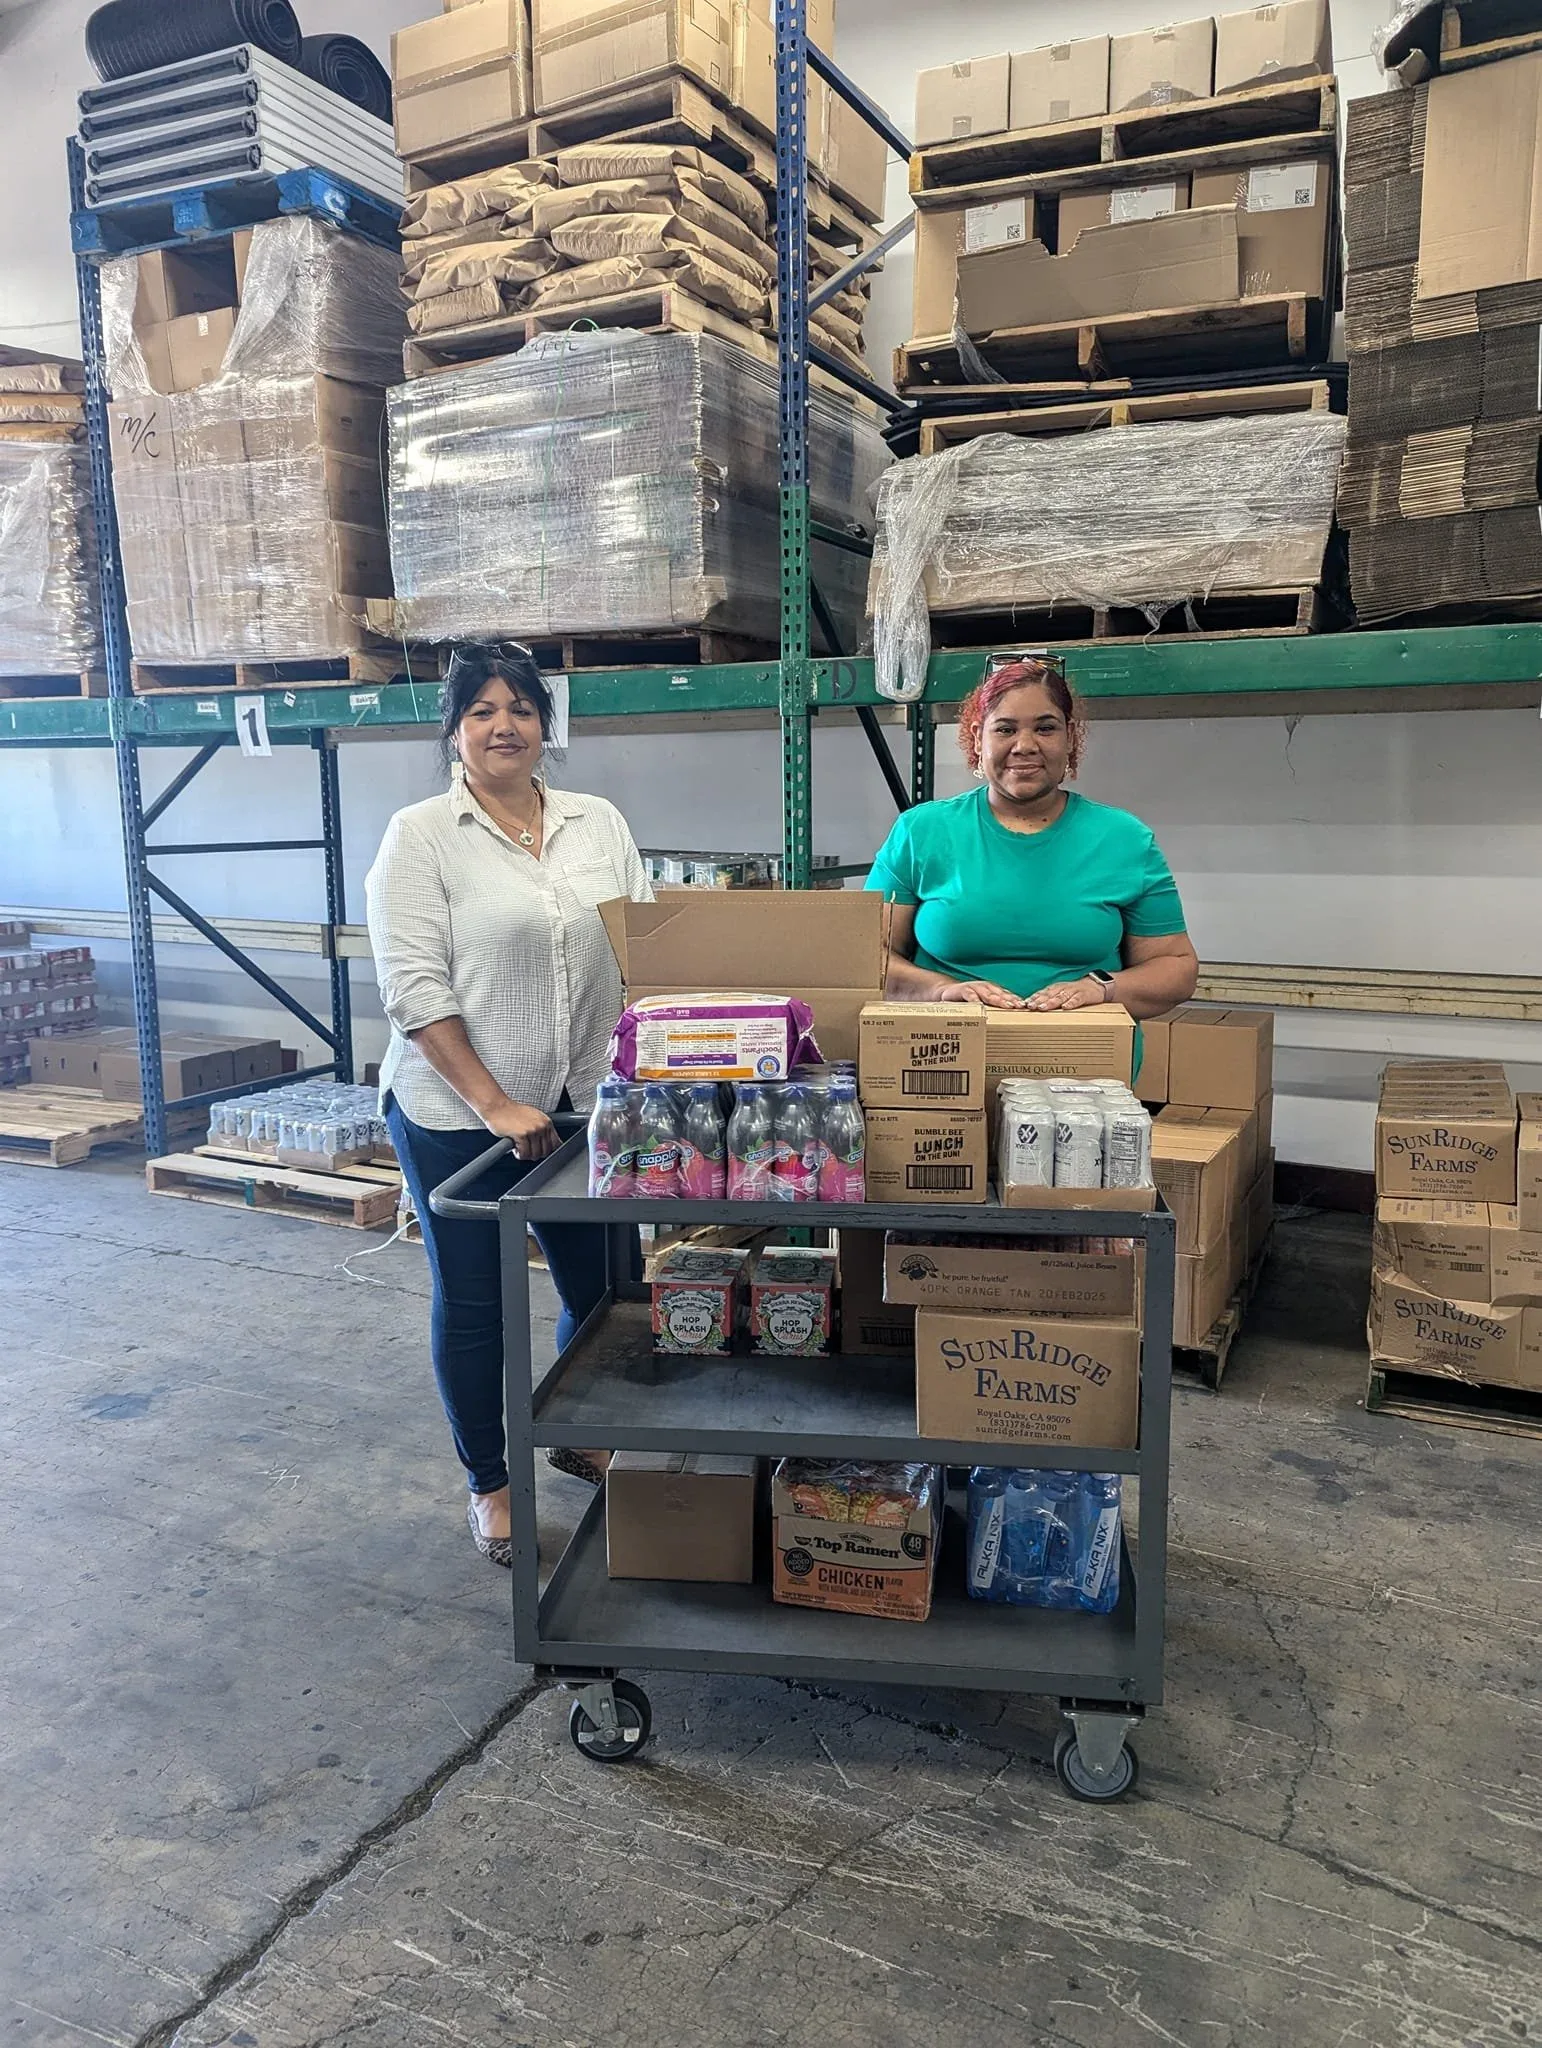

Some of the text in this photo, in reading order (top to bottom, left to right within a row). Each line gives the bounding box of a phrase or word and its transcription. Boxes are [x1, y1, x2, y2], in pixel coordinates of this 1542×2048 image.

[831, 659, 857, 700] D
[241, 707, 261, 747] 1
[910, 1041, 960, 1060] LUNCH
[911, 1055, 957, 1067] ON THE RUN!
[986, 1066, 1078, 1075] PREMIUM QUALITY
[914, 1128, 965, 1136] BUMBLE BEE
[914, 1136, 964, 1155] LUNCH
[639, 1149, 678, 1166] snapple
[915, 1150, 960, 1162] ON THE RUN!
[942, 1273, 951, 1281] be
[970, 1273, 980, 1282] be
[920, 1284, 949, 1294] 40PK
[957, 1286, 1001, 1297] ORANGE
[1010, 1288, 1031, 1299] TAN
[673, 1324, 707, 1333] SPLASH
[774, 1326, 808, 1334] SPLASH
[977, 1408, 1072, 1424] Royal Oaks, CA 95076
[990, 1418, 1057, 1432] (831)786-7000
[975, 1426, 1072, 1441] sunridgefarms.com
[814, 1537, 898, 1560] Top Ramen
[908, 1536, 922, 1550] 48
[977, 1540, 995, 1580] ALKA
[1084, 1526, 1109, 1589] ALKA NIX
[818, 1567, 885, 1590] CHICKEN
